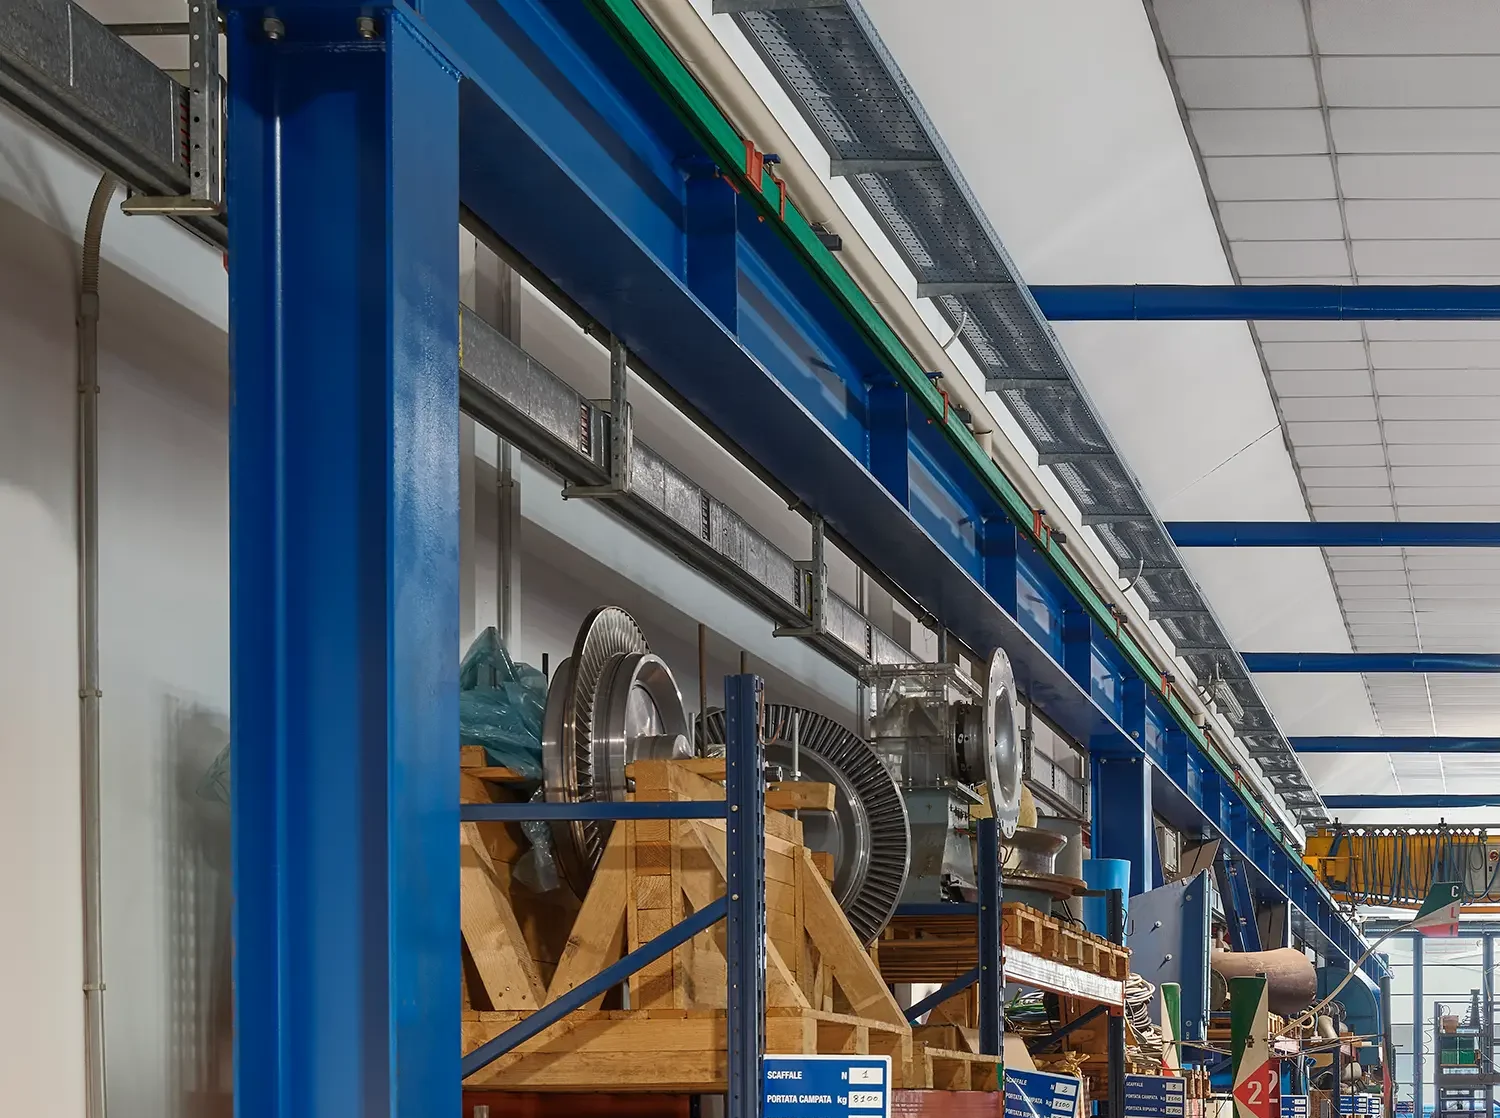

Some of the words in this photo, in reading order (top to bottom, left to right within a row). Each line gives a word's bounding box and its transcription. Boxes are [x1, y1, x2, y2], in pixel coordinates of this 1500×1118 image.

[1451, 885, 1459, 897] C
[1451, 906, 1456, 918] L
[767, 1071, 802, 1080] SCAFFALE
[841, 1071, 847, 1080] N
[861, 1070, 869, 1079] 1
[1247, 1081, 1262, 1104] 2
[766, 1095, 798, 1104] PORTATA
[799, 1095, 832, 1104] CAMPATA
[837, 1095, 847, 1105] kg
[852, 1094, 878, 1103] 8100
[1005, 1092, 1022, 1101] PORTATA
[1045, 1099, 1052, 1107] kg
[1005, 1107, 1022, 1117] PORTATA
